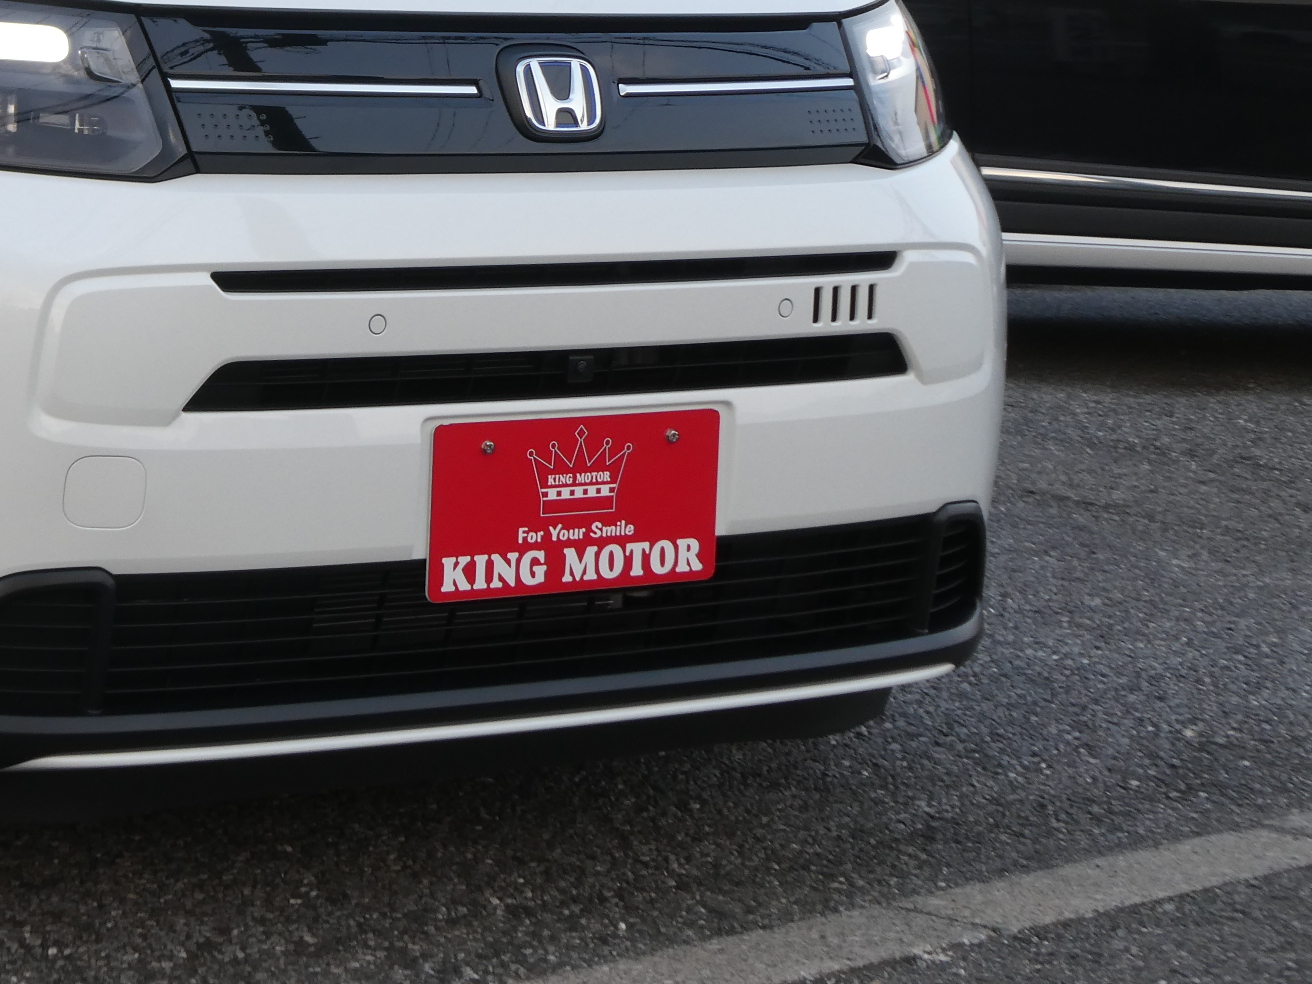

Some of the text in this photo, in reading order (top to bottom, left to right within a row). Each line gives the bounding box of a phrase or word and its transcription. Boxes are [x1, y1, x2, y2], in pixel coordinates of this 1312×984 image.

[547, 470, 611, 486] KING MOTOR
[517, 519, 635, 544] For Your Smile
[440, 537, 704, 593] KING MOTOR
